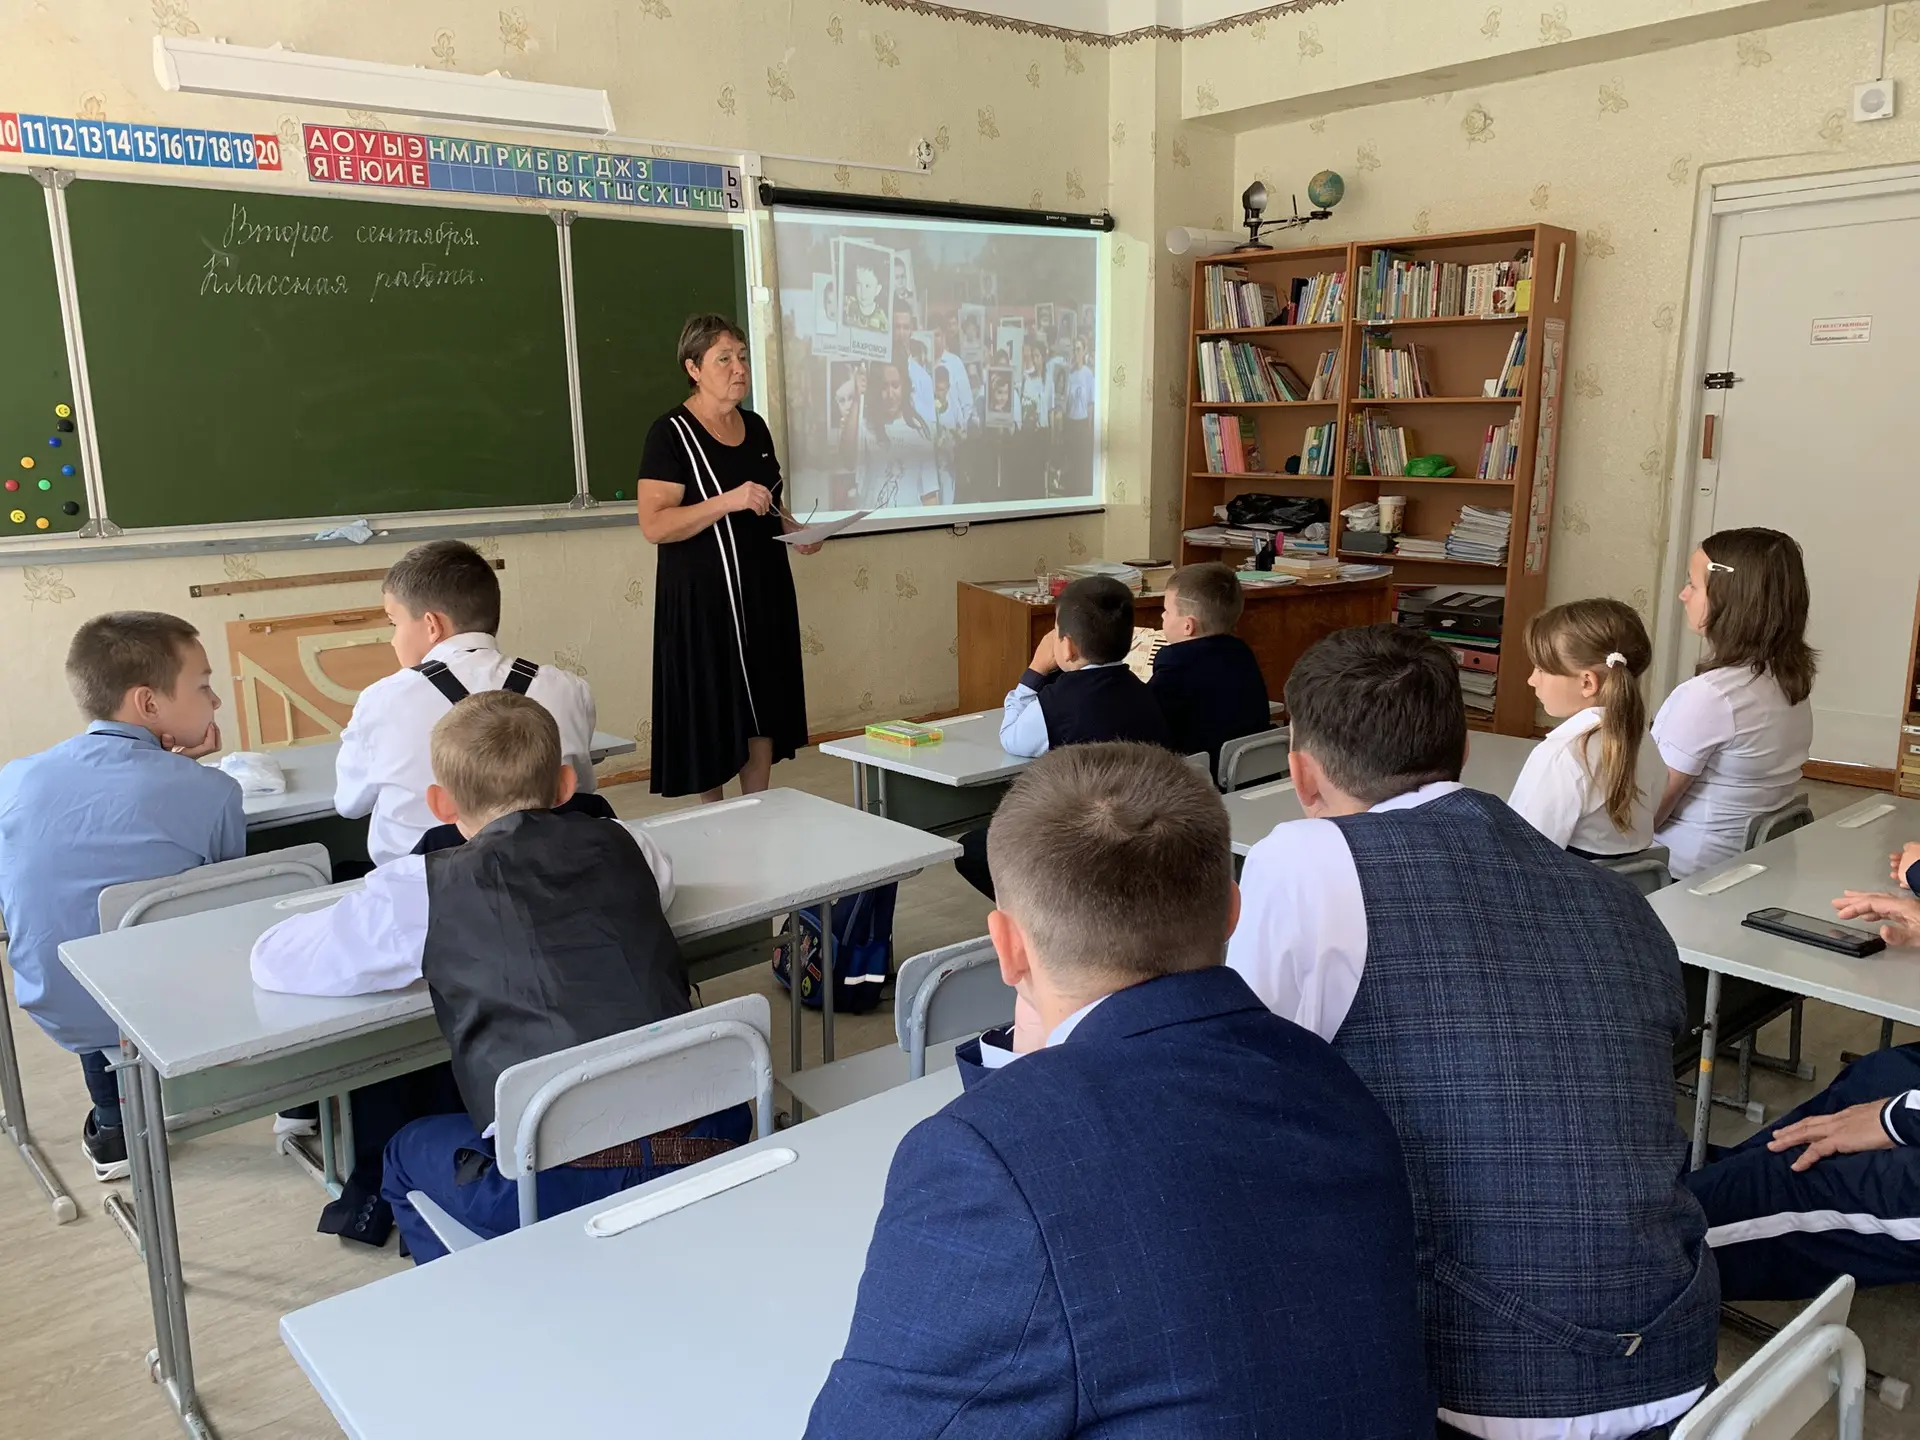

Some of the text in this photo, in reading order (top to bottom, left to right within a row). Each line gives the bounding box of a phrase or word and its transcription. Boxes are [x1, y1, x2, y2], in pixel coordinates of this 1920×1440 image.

[22, 121, 46, 149] 11
[51, 123, 76, 151] 12
[79, 126, 102, 153] 13
[106, 129, 131, 156] 14
[134, 131, 157, 158] 15
[160, 132, 183, 159] 16
[185, 135, 206, 161] 17
[209, 137, 231, 163] 18
[233, 139, 254, 164] 19
[257, 140, 279, 165] 20
[223, 203, 333, 258] Второе
[200, 254, 348, 295] Классная
